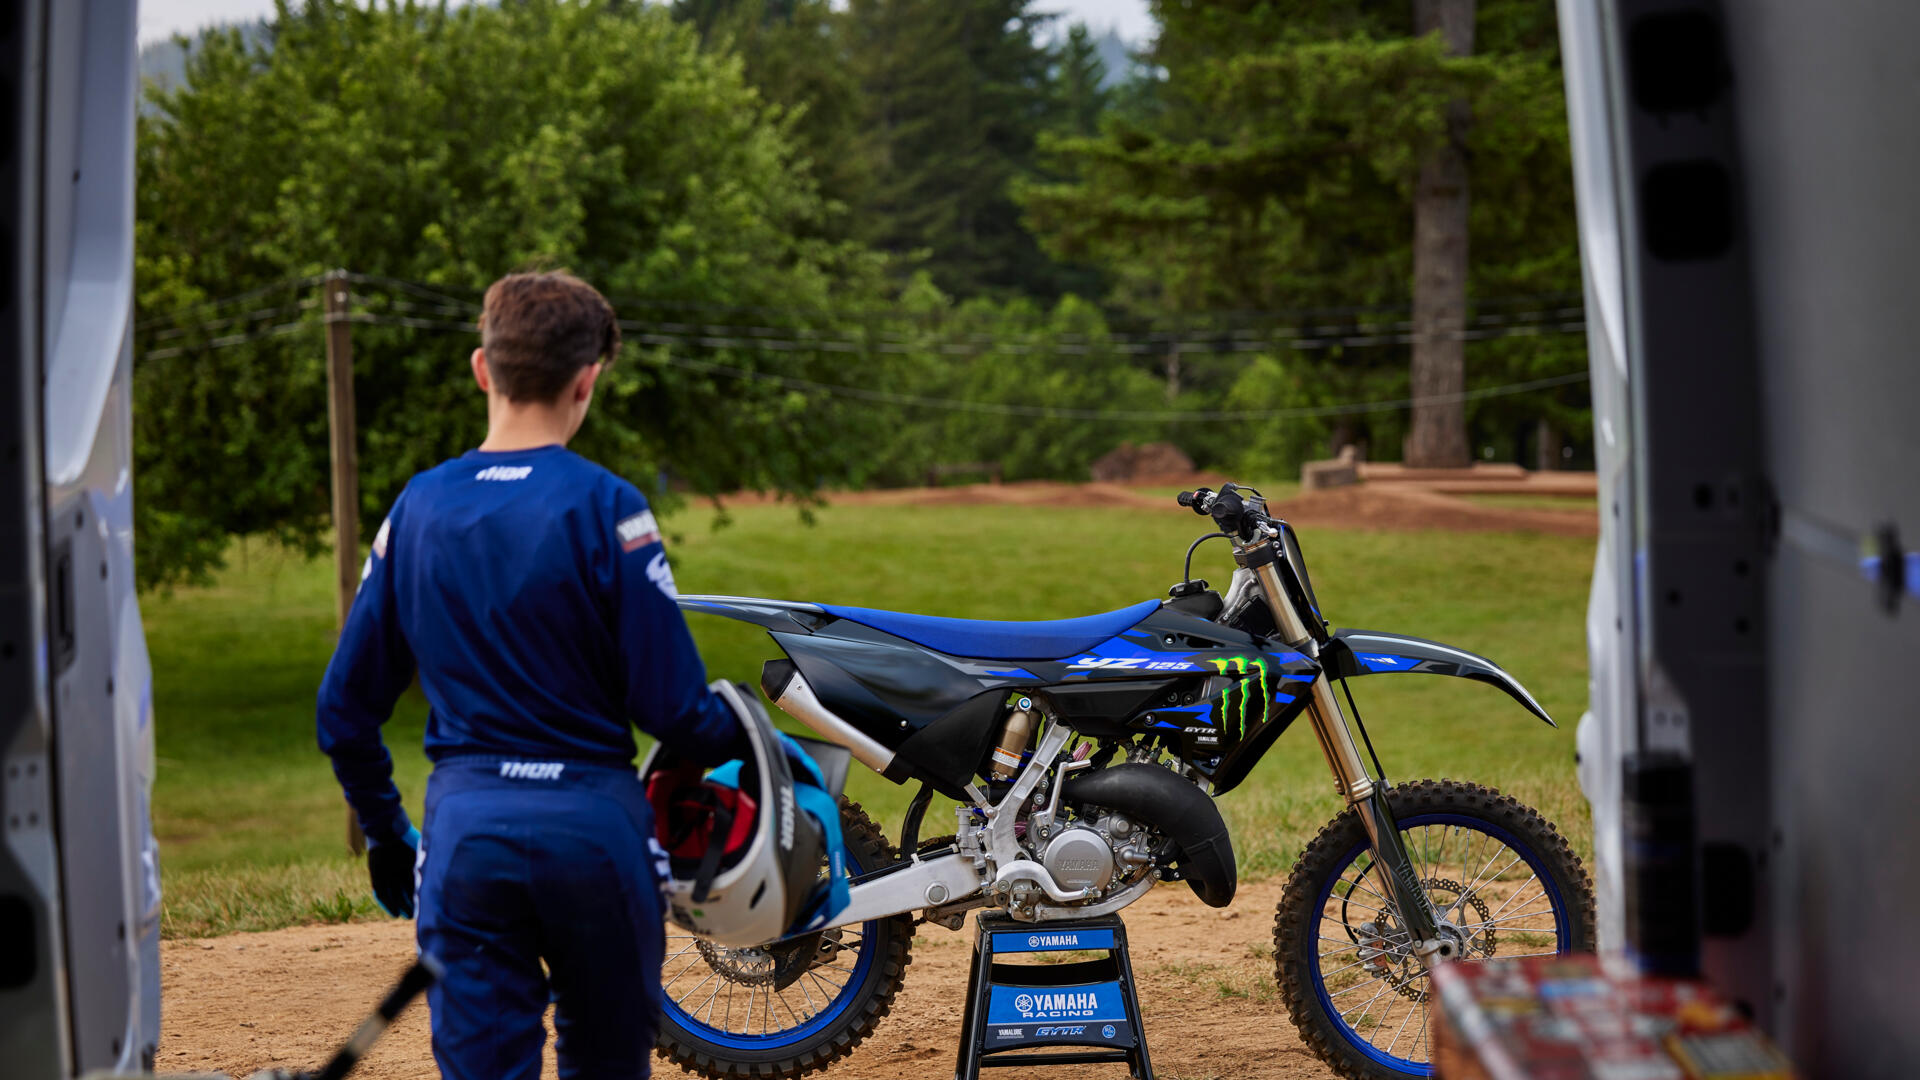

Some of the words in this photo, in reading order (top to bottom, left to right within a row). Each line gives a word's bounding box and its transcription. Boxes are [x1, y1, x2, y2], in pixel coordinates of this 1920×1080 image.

[1065, 657, 1151, 669] YZ
[1144, 661, 1195, 670] 125
[1184, 726, 1217, 734] GYTR
[500, 761, 565, 780] THOR
[779, 785, 795, 850] THOR
[1039, 934, 1078, 946] YAMAHA
[1033, 992, 1098, 1011] YAMAHA
[1022, 1010, 1094, 1018] RACING
